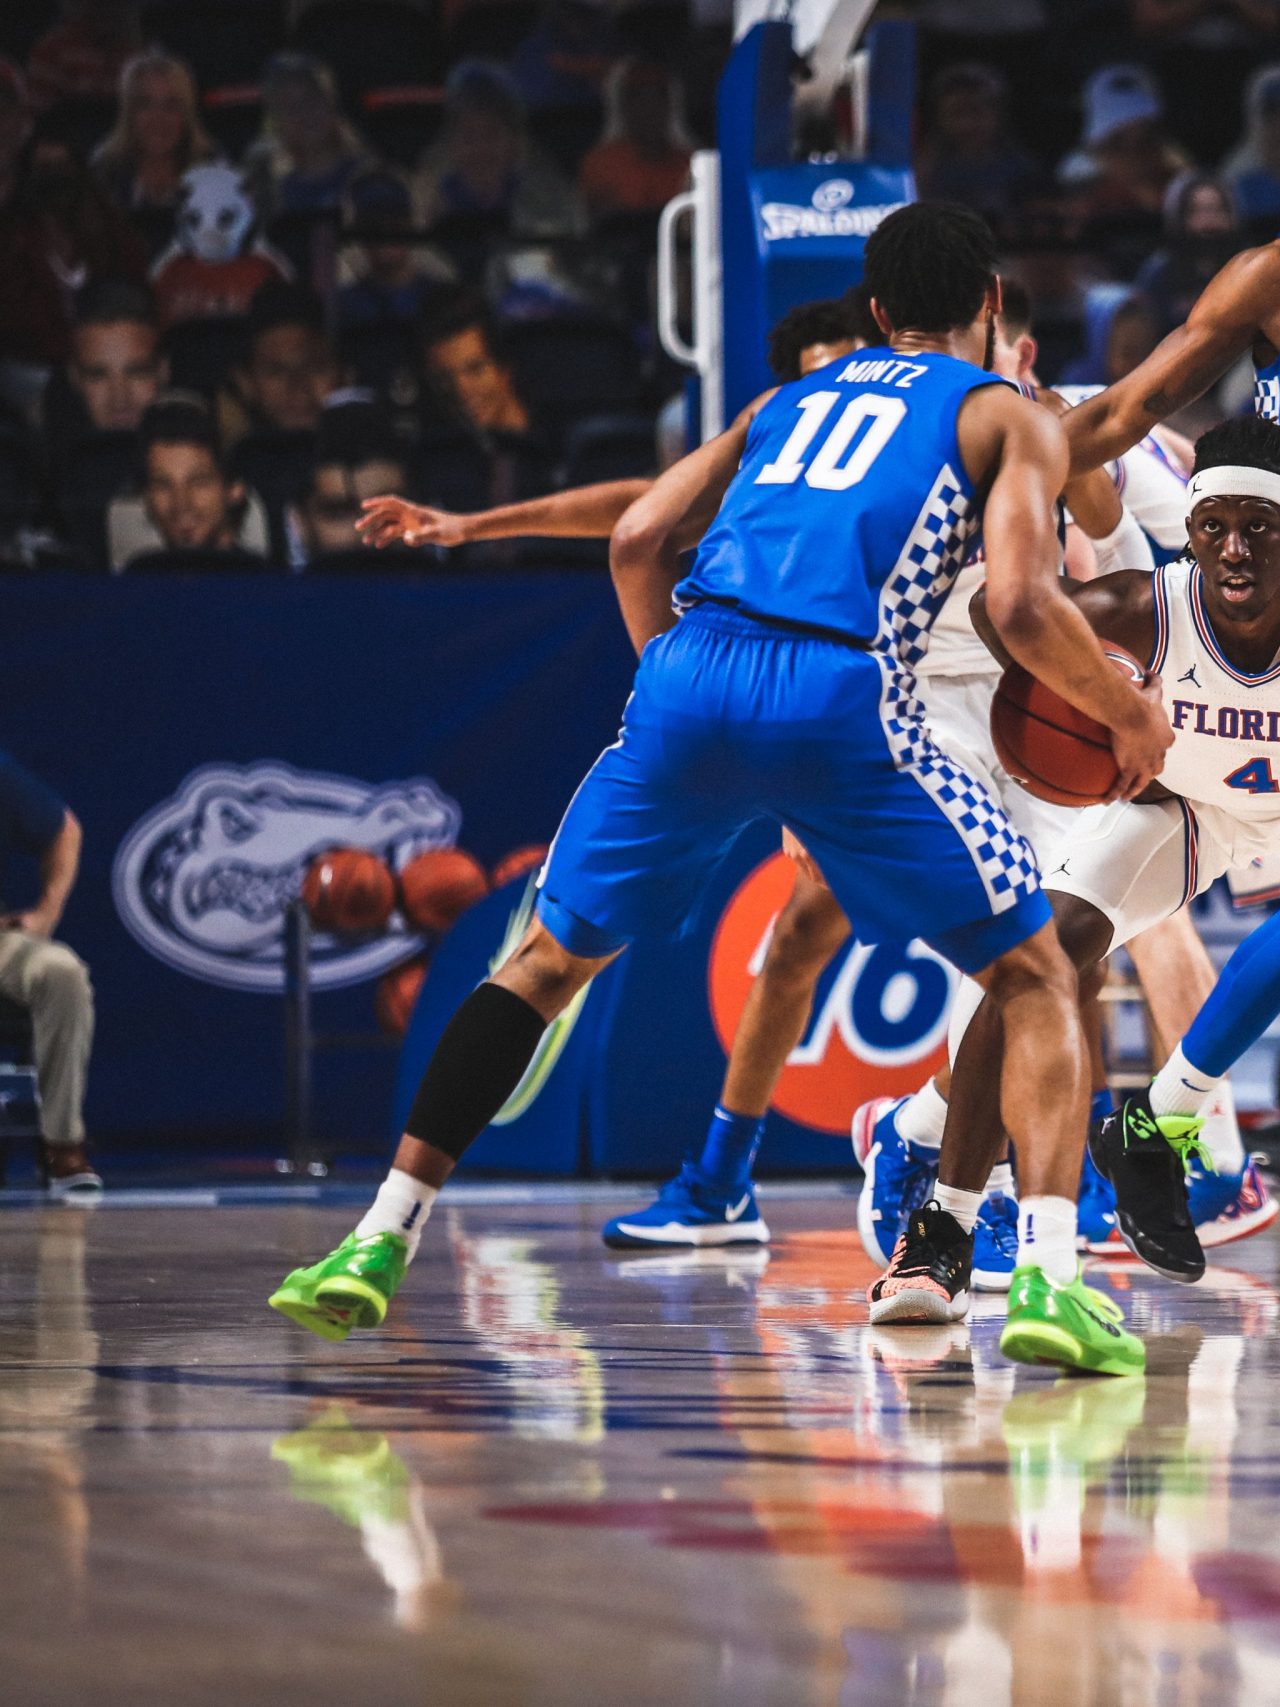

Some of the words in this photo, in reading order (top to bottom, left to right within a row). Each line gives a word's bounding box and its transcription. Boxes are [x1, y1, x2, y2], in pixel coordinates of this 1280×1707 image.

[835, 360, 929, 388] MINTZ
[753, 390, 908, 491] 10
[1223, 757, 1280, 794] 4
